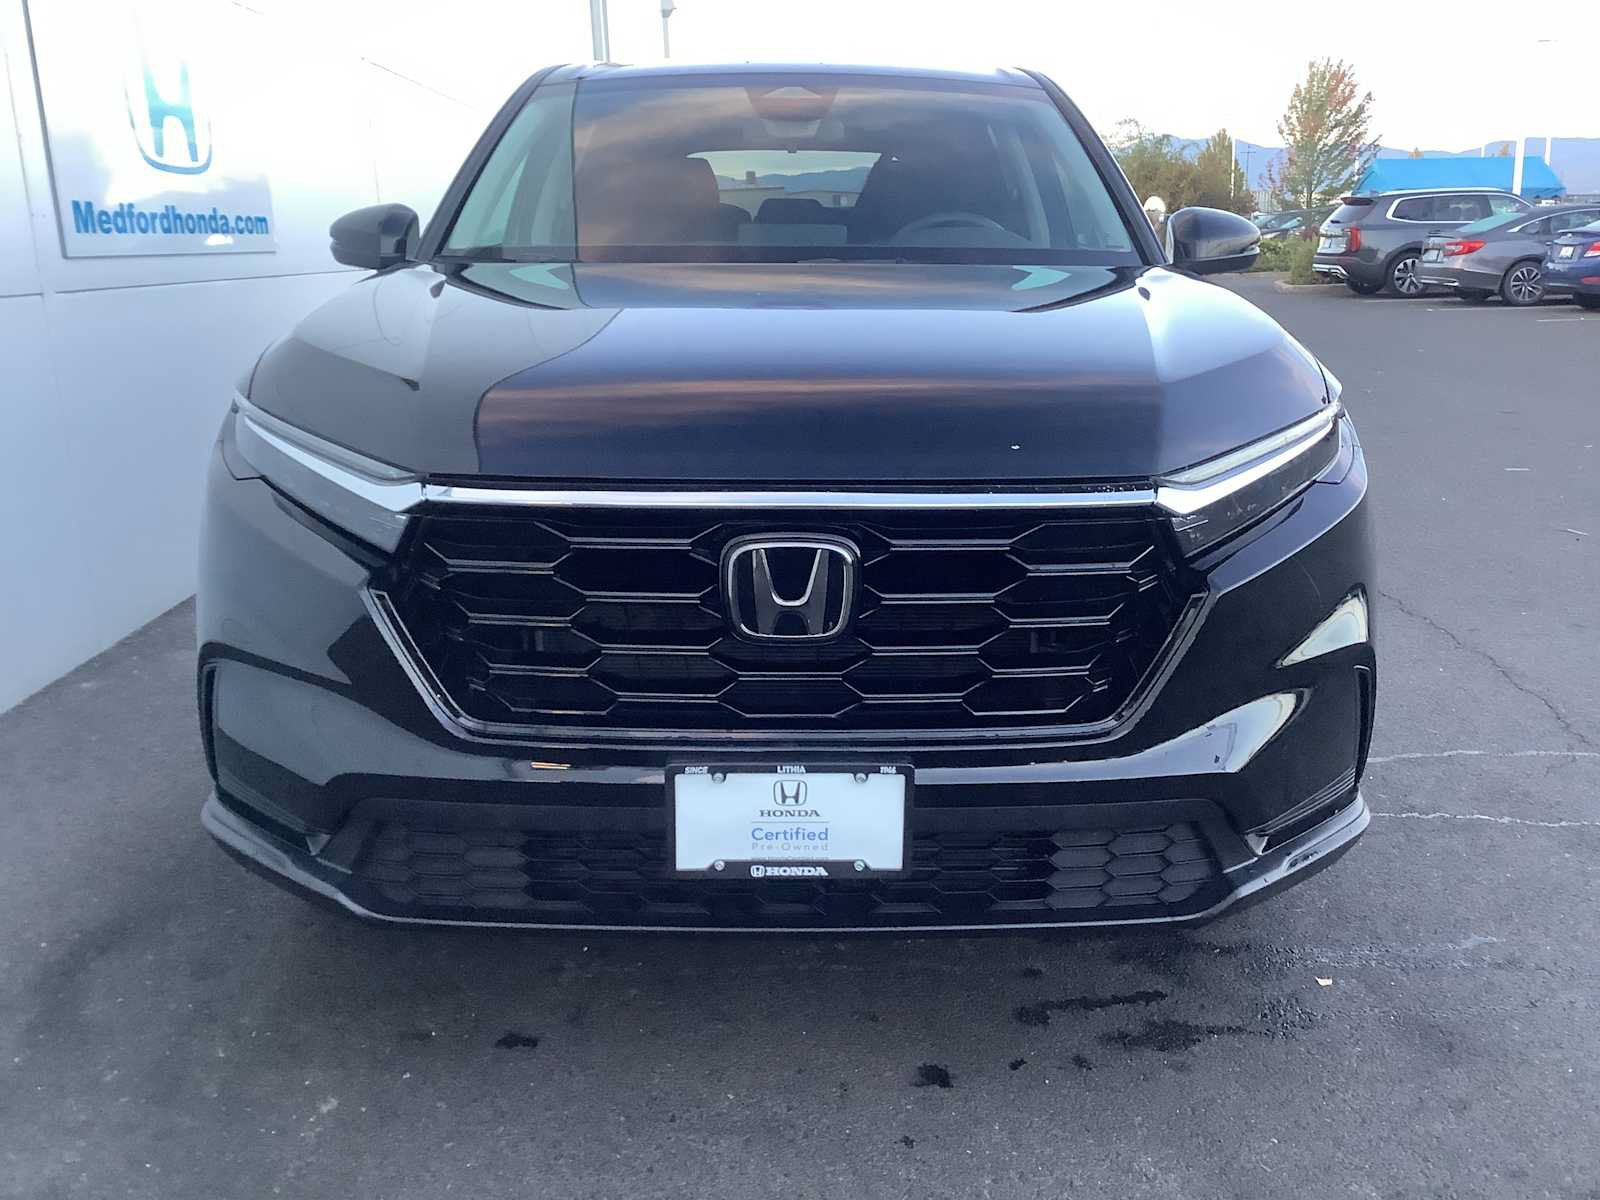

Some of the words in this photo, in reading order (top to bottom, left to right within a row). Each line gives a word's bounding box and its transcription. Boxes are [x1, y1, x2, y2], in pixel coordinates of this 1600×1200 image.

[71, 199, 269, 235] Medfordhonda.com
[776, 765, 807, 774] LITHIA
[759, 809, 821, 817] HONDA
[751, 827, 829, 841] Certified
[751, 842, 829, 851] Pre-Owned
[765, 866, 829, 876] HONDA
